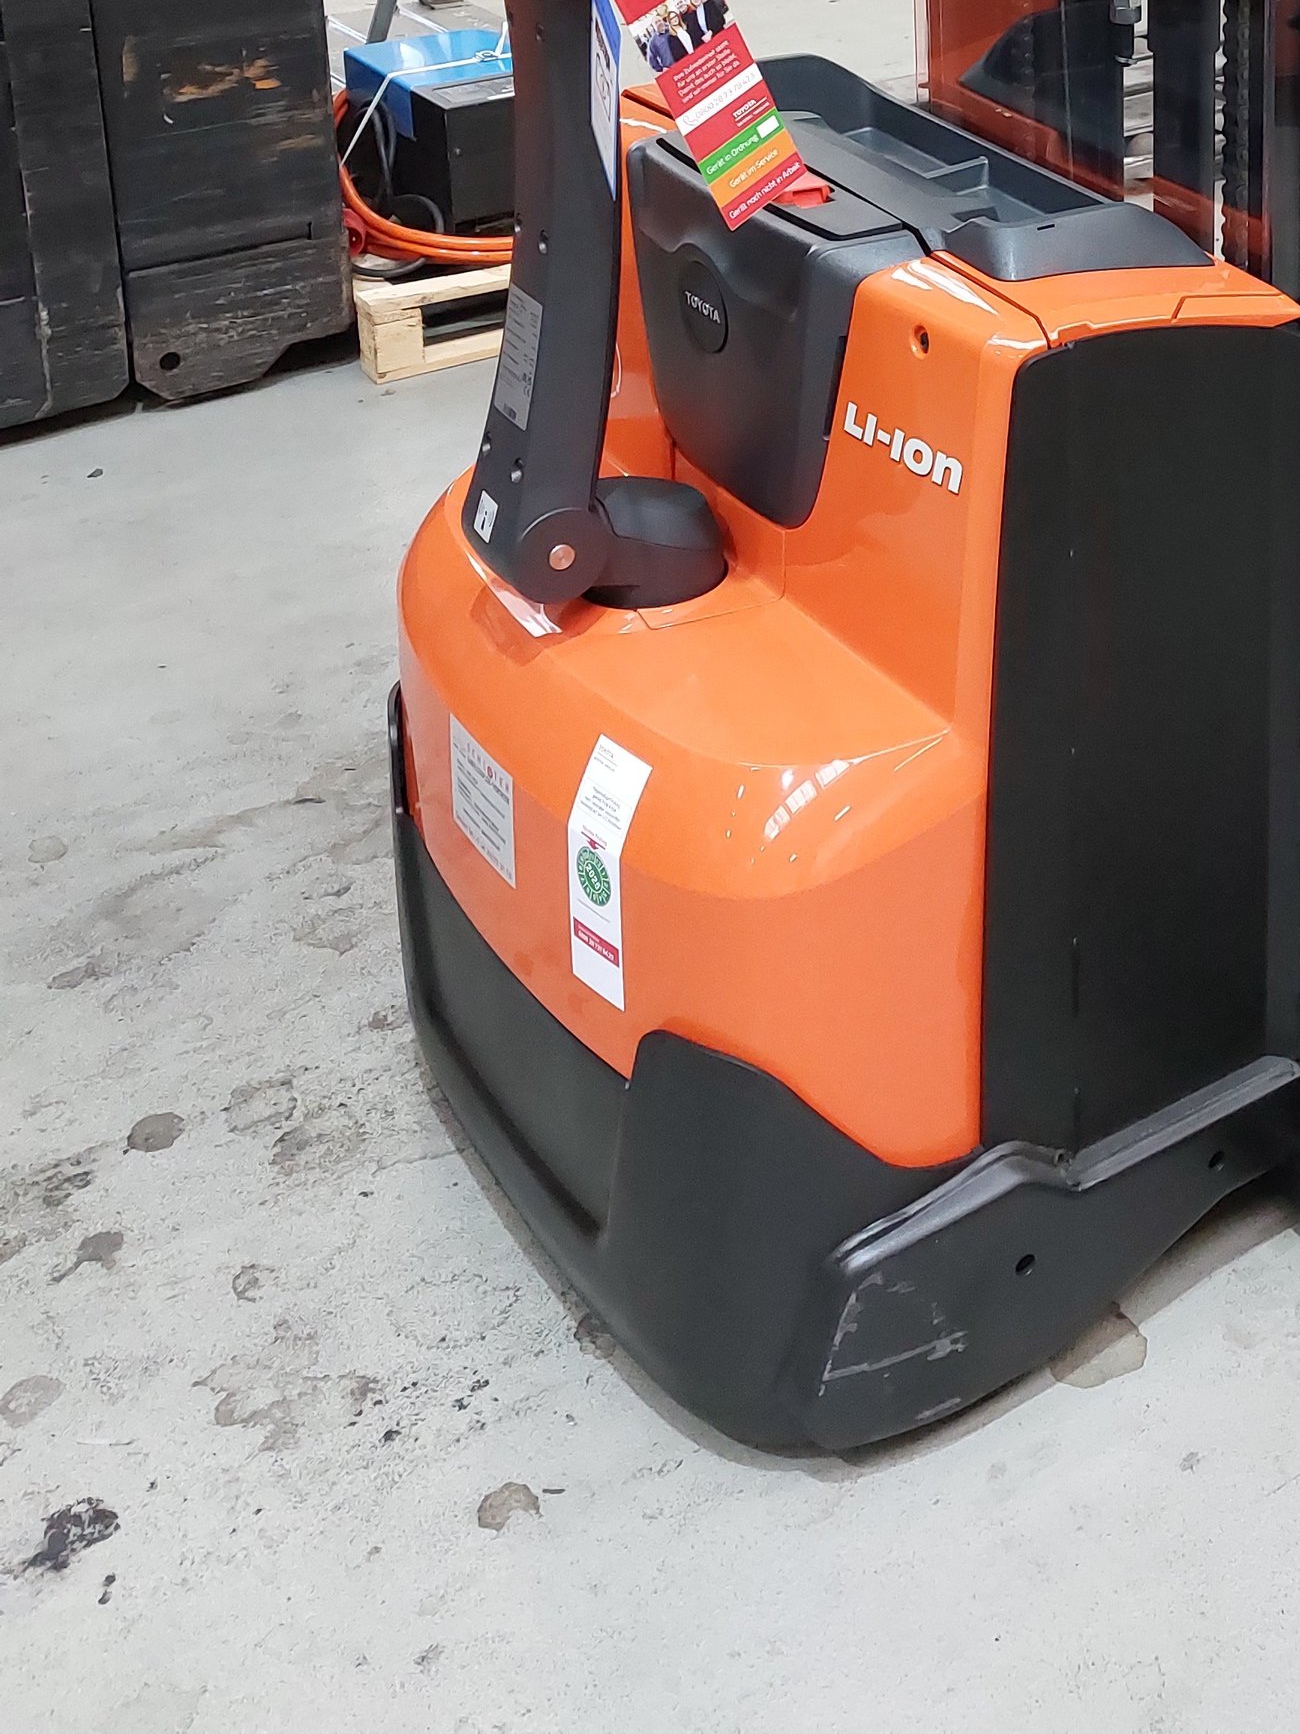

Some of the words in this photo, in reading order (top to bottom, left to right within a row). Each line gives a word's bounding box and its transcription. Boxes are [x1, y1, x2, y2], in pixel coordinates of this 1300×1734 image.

[706, 158, 724, 175] Gerät
[731, 134, 759, 158] Ordnung
[730, 171, 748, 188] Gerät
[755, 149, 778, 169] Service
[729, 202, 747, 219] Gerät
[746, 190, 763, 207] noch
[761, 179, 777, 196] nicht
[782, 162, 801, 179] Arbeit
[684, 290, 721, 324] TOYOTA
